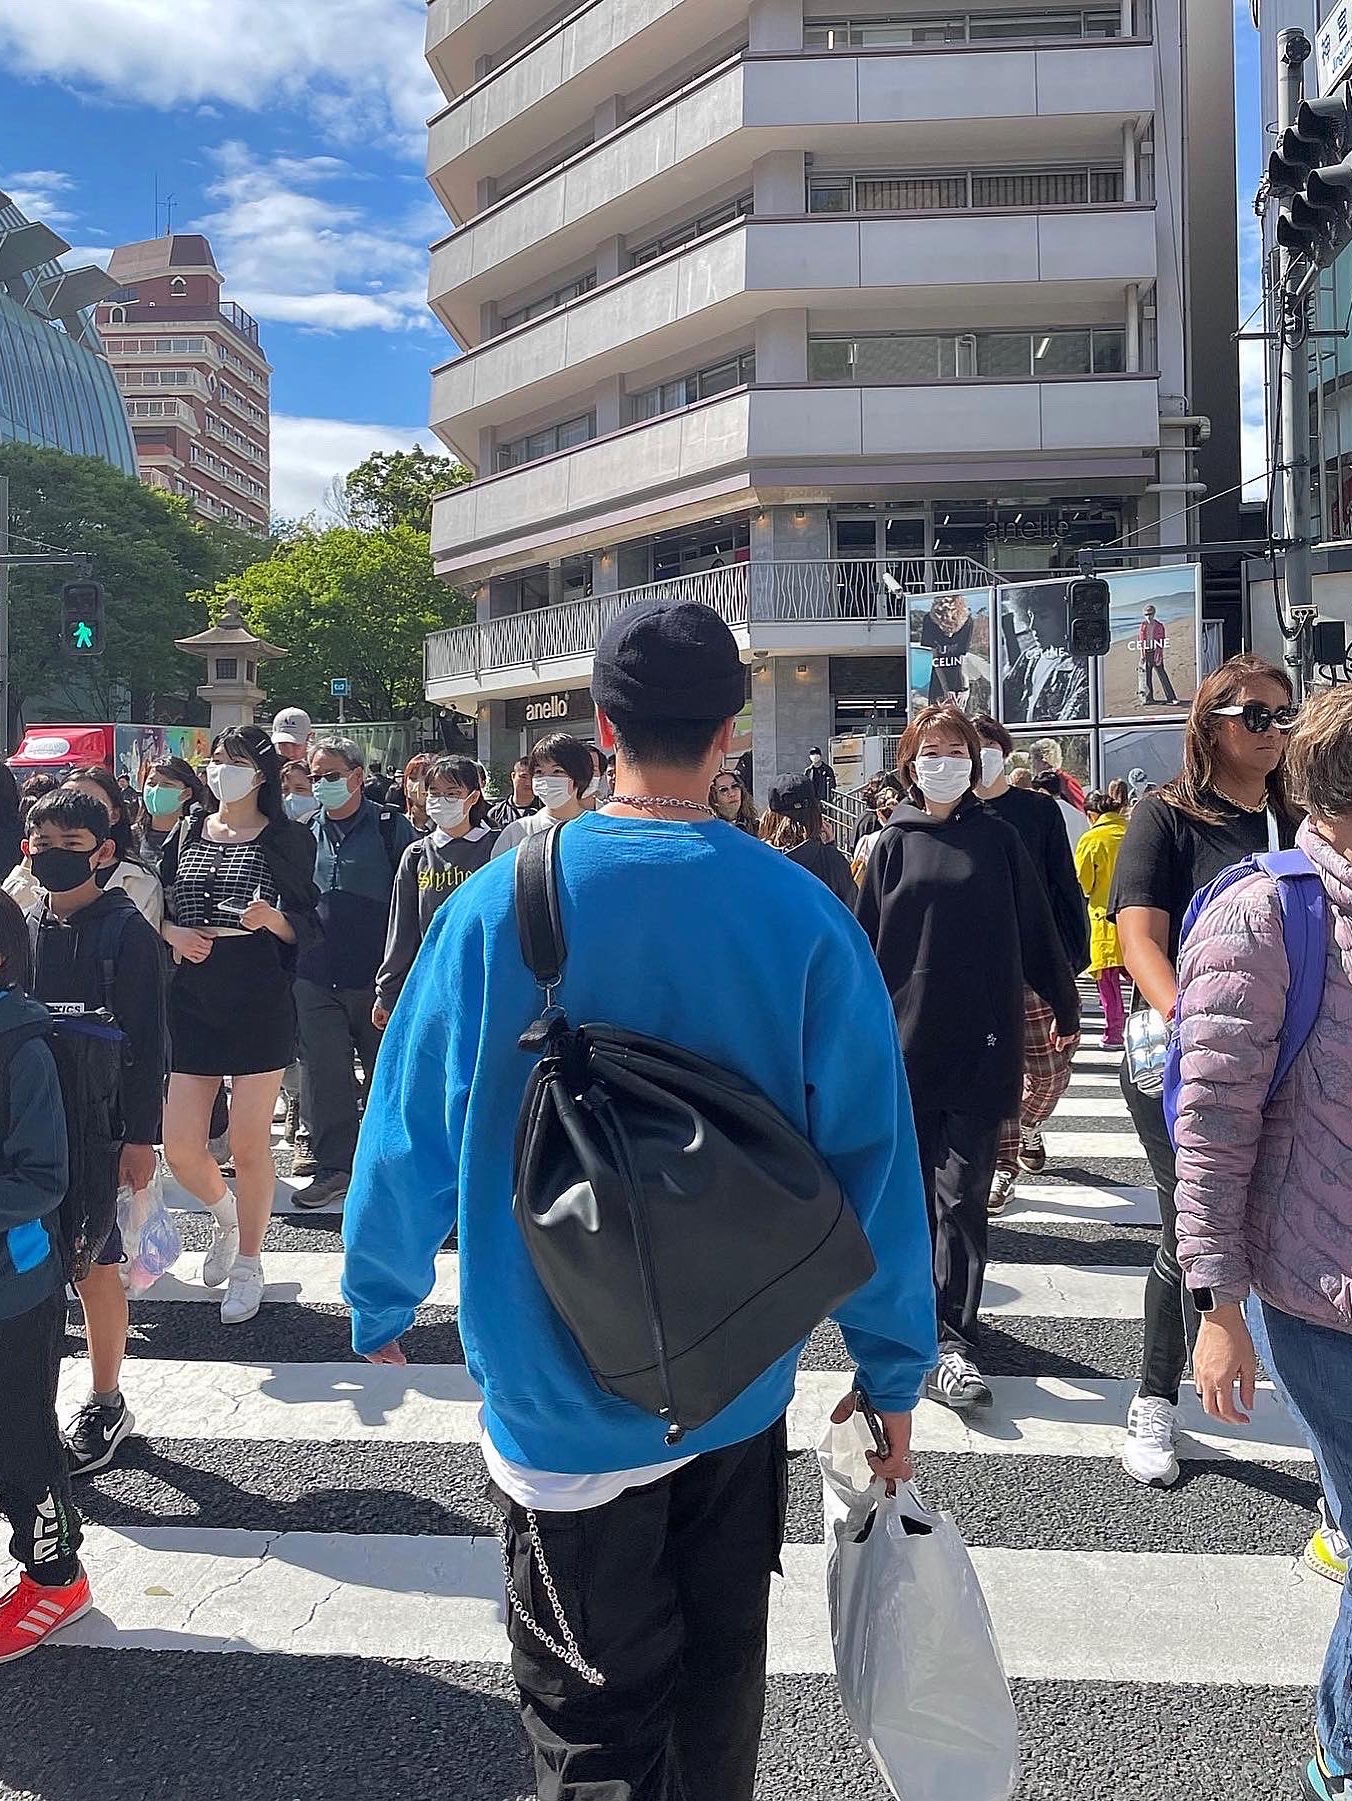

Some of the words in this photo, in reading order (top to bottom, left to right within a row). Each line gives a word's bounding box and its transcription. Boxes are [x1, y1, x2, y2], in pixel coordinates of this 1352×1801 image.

[1127, 637, 1171, 651] CELINE
[931, 656, 967, 668] CELIN
[525, 695, 568, 721] anello
